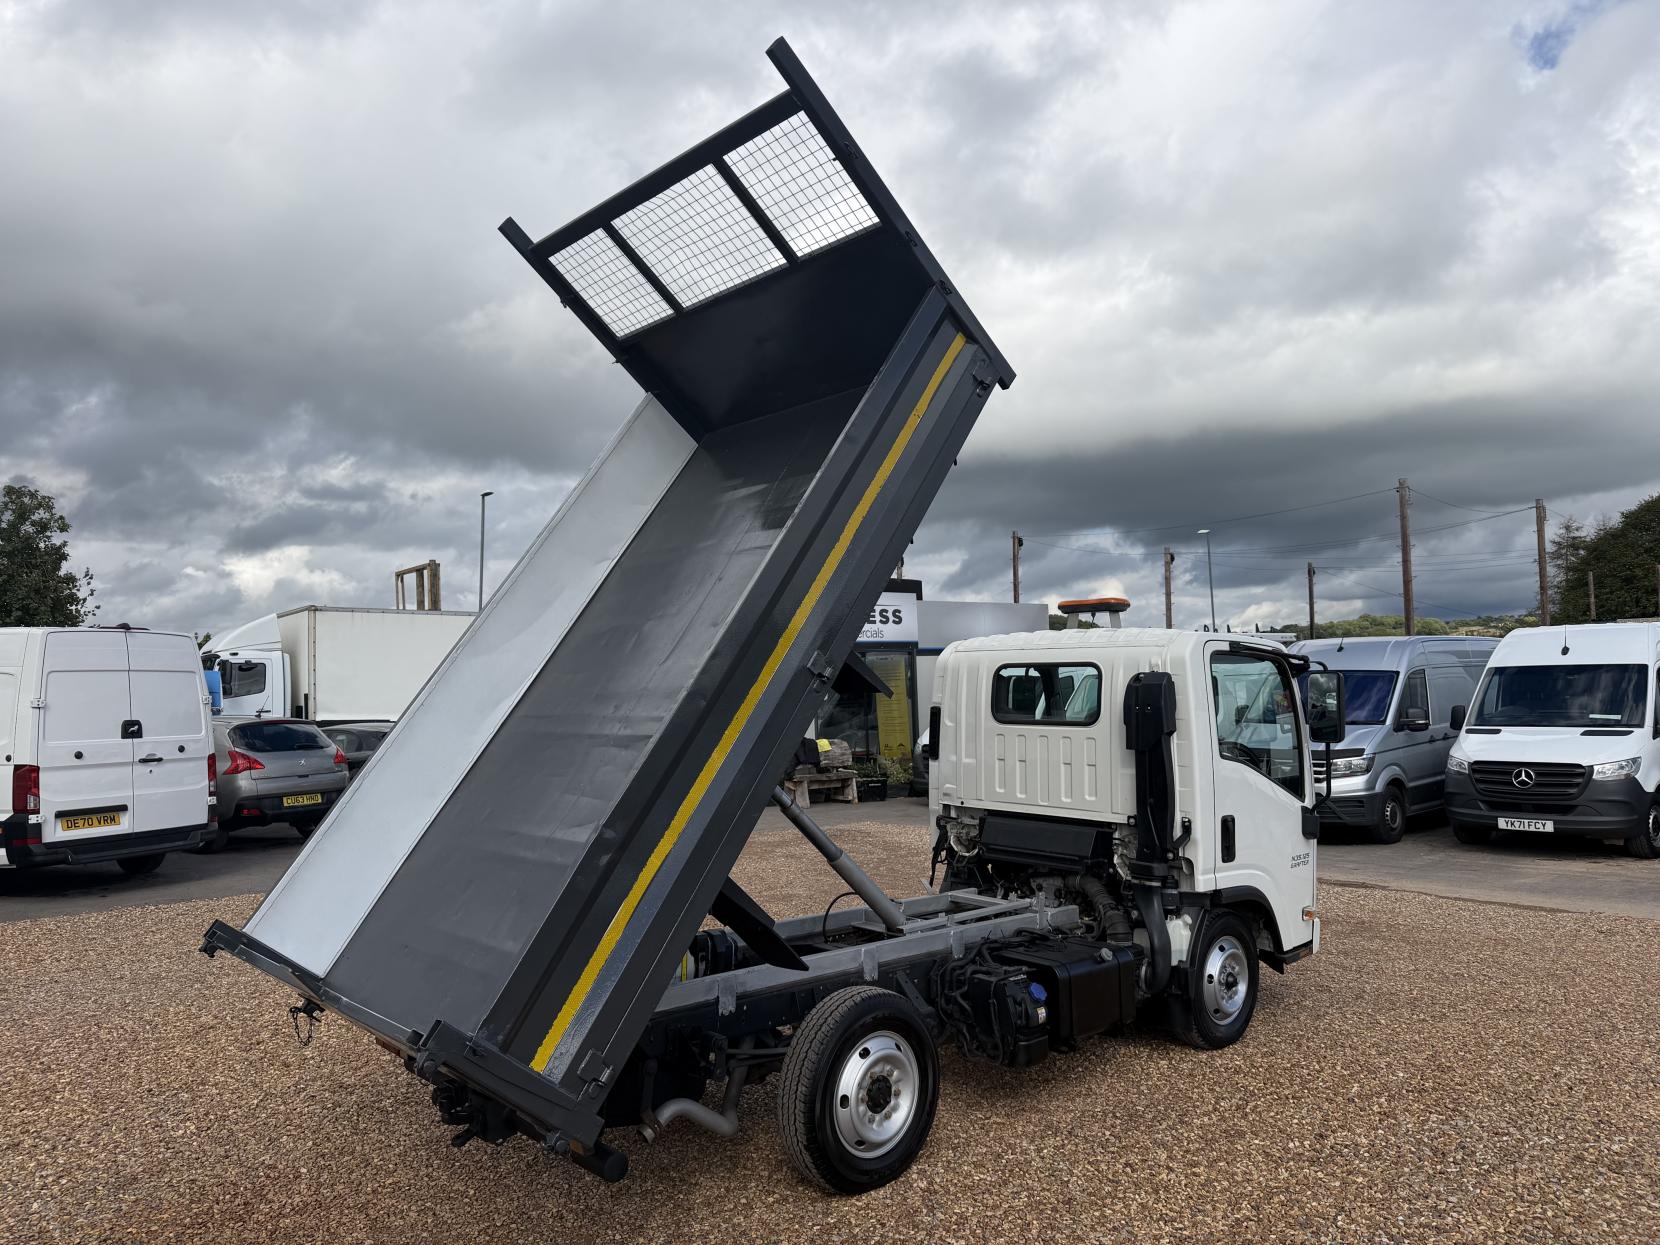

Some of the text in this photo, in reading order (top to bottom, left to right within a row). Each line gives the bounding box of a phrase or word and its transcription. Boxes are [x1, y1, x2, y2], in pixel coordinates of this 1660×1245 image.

[286, 797, 305, 805] CU63
[66, 814, 117, 829] DE70 VRM
[1504, 819, 1547, 831] YK71 FCY
